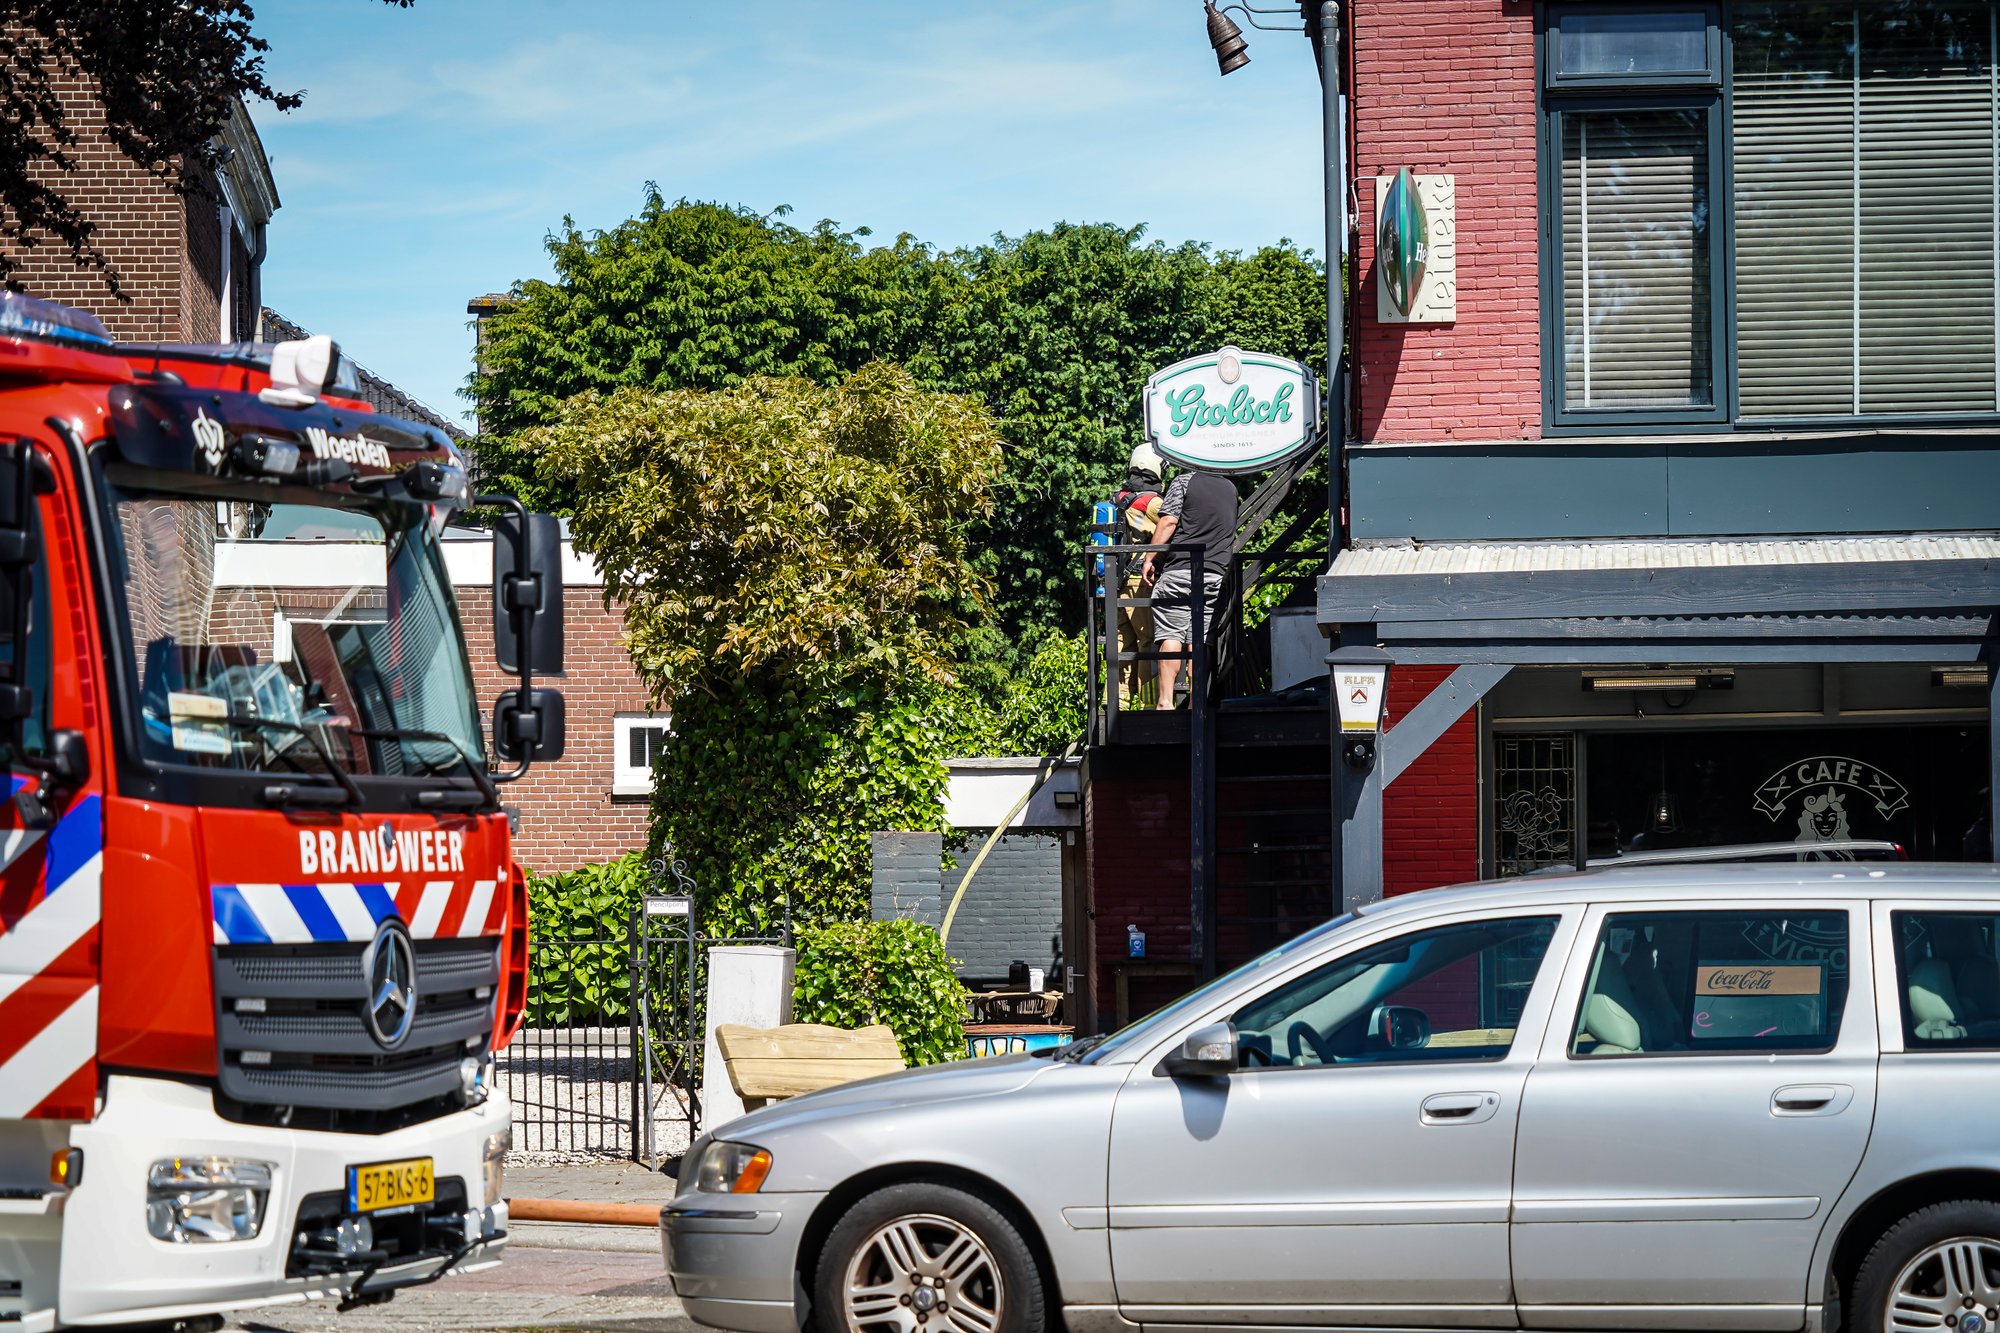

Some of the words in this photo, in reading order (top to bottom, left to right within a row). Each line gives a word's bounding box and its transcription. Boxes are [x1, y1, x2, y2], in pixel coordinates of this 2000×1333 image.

[1165, 381, 1294, 437] Grolsch
[306, 426, 390, 468] Woerden
[1344, 676, 1376, 685] ALFA
[1797, 761, 1862, 784] CAFE
[299, 830, 464, 874] BRANDWEER
[1707, 969, 1776, 990] Coca-Cola
[364, 1166, 428, 1203] 57-BKS-6
